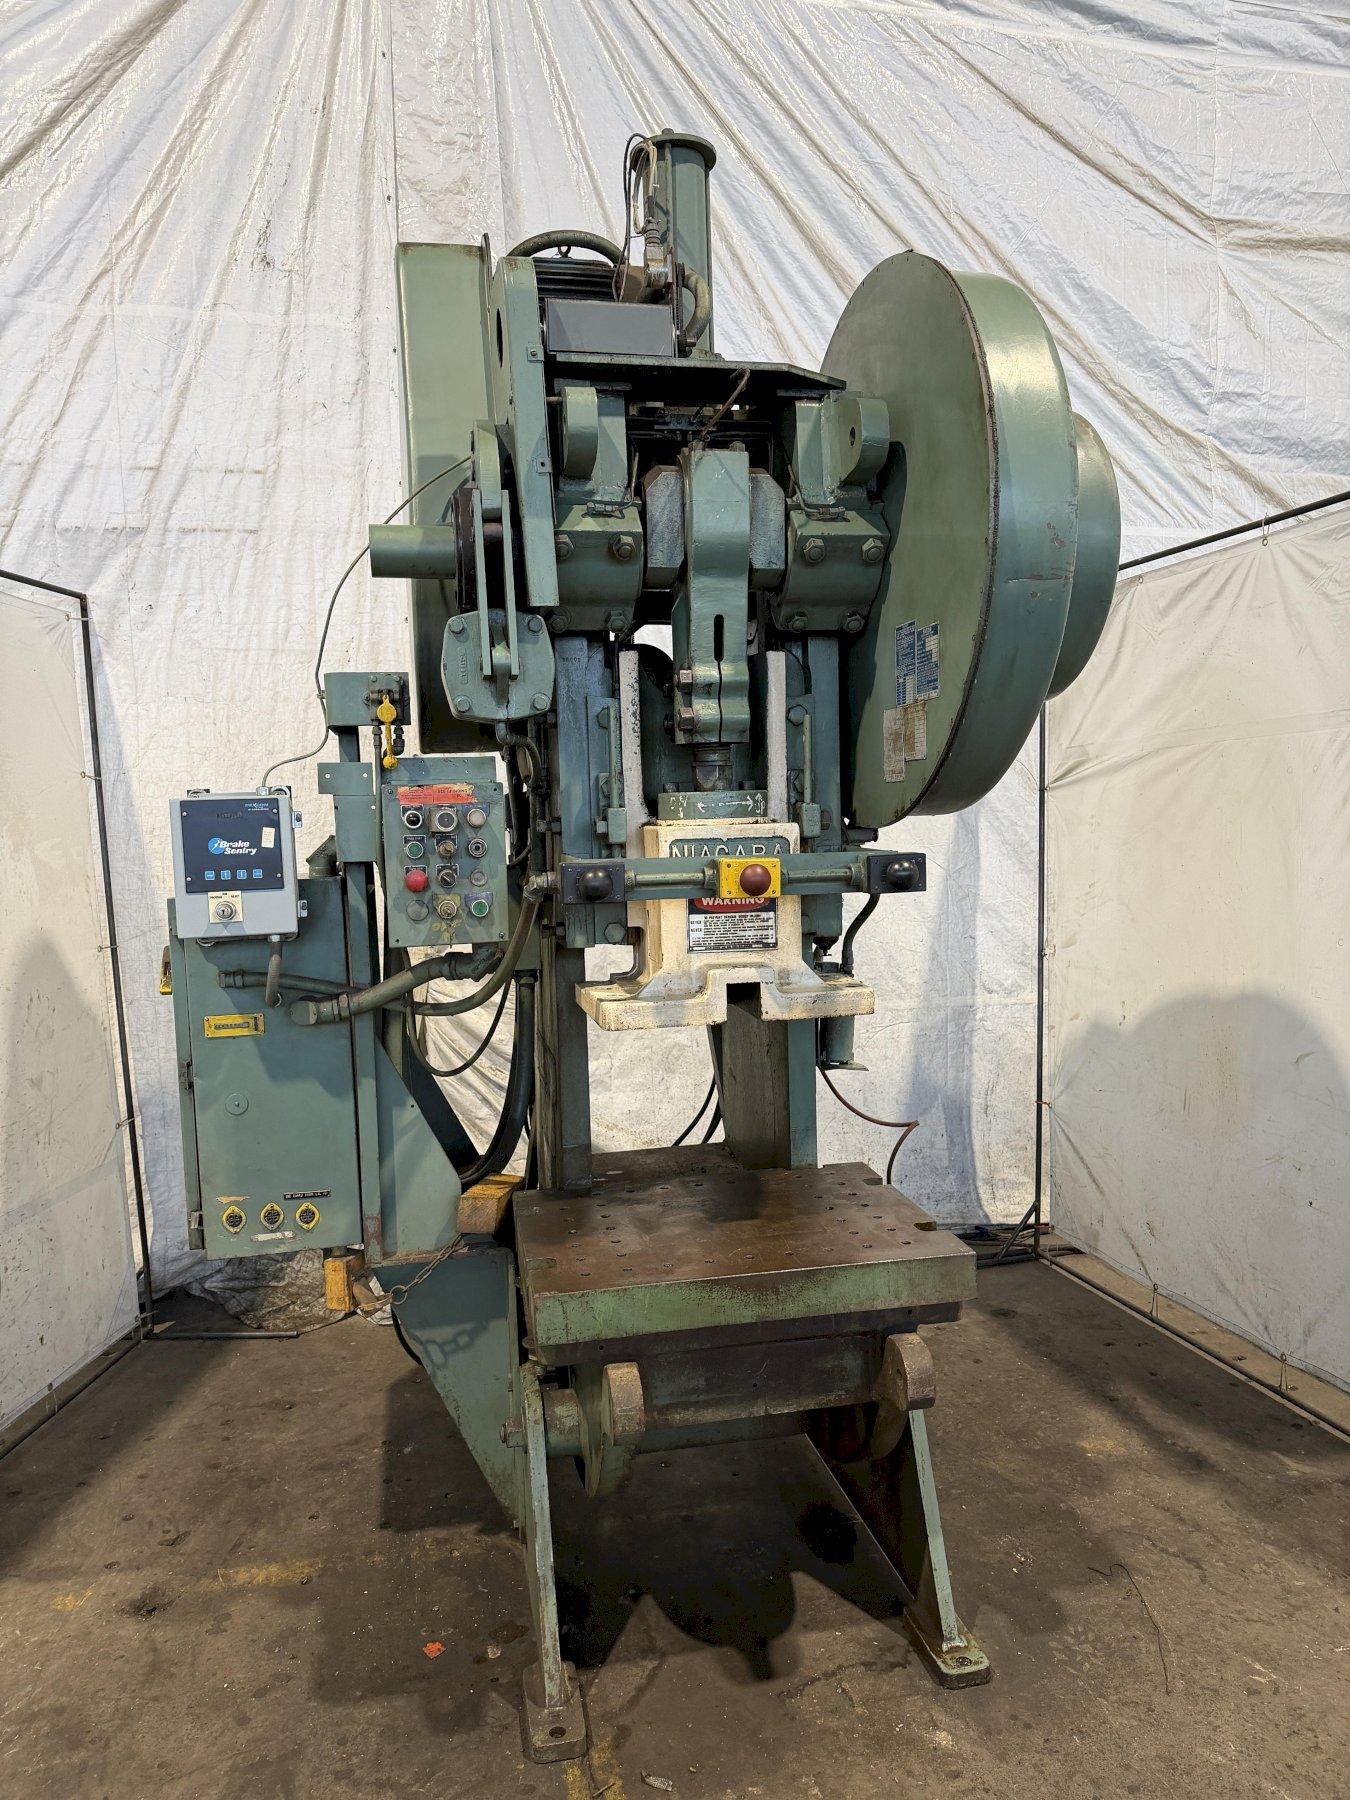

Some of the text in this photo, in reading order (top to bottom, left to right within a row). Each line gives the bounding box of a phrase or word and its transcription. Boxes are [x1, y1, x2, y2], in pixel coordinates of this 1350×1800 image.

[219, 839, 250, 849] Brake
[223, 847, 258, 856] Sentry
[701, 897, 765, 906] WARNING
